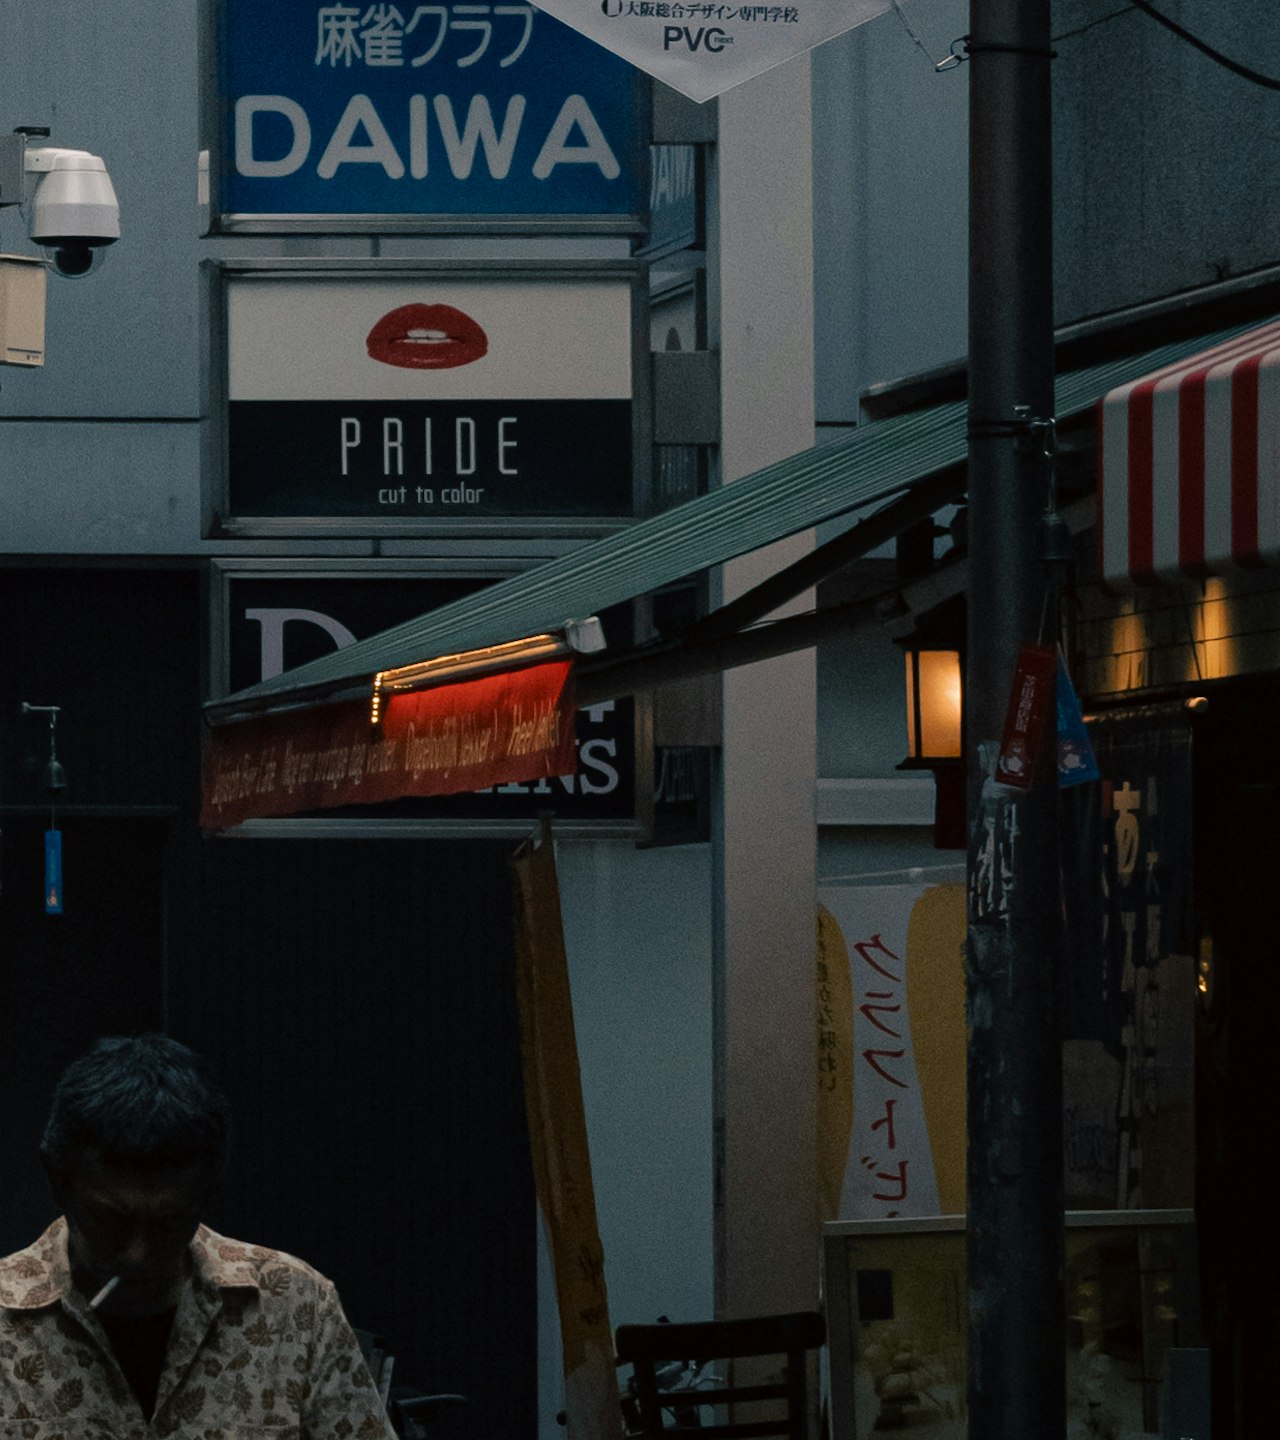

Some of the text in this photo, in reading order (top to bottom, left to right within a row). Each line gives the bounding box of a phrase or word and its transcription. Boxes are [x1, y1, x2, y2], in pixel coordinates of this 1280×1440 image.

[625, 0, 799, 24] 大阪総合デザイン専門学校
[663, 25, 726, 53] PVC
[234, 92, 622, 182] DAIWA
[340, 417, 521, 477] PRIDE
[378, 483, 408, 506] cut
[440, 482, 485, 506] color
